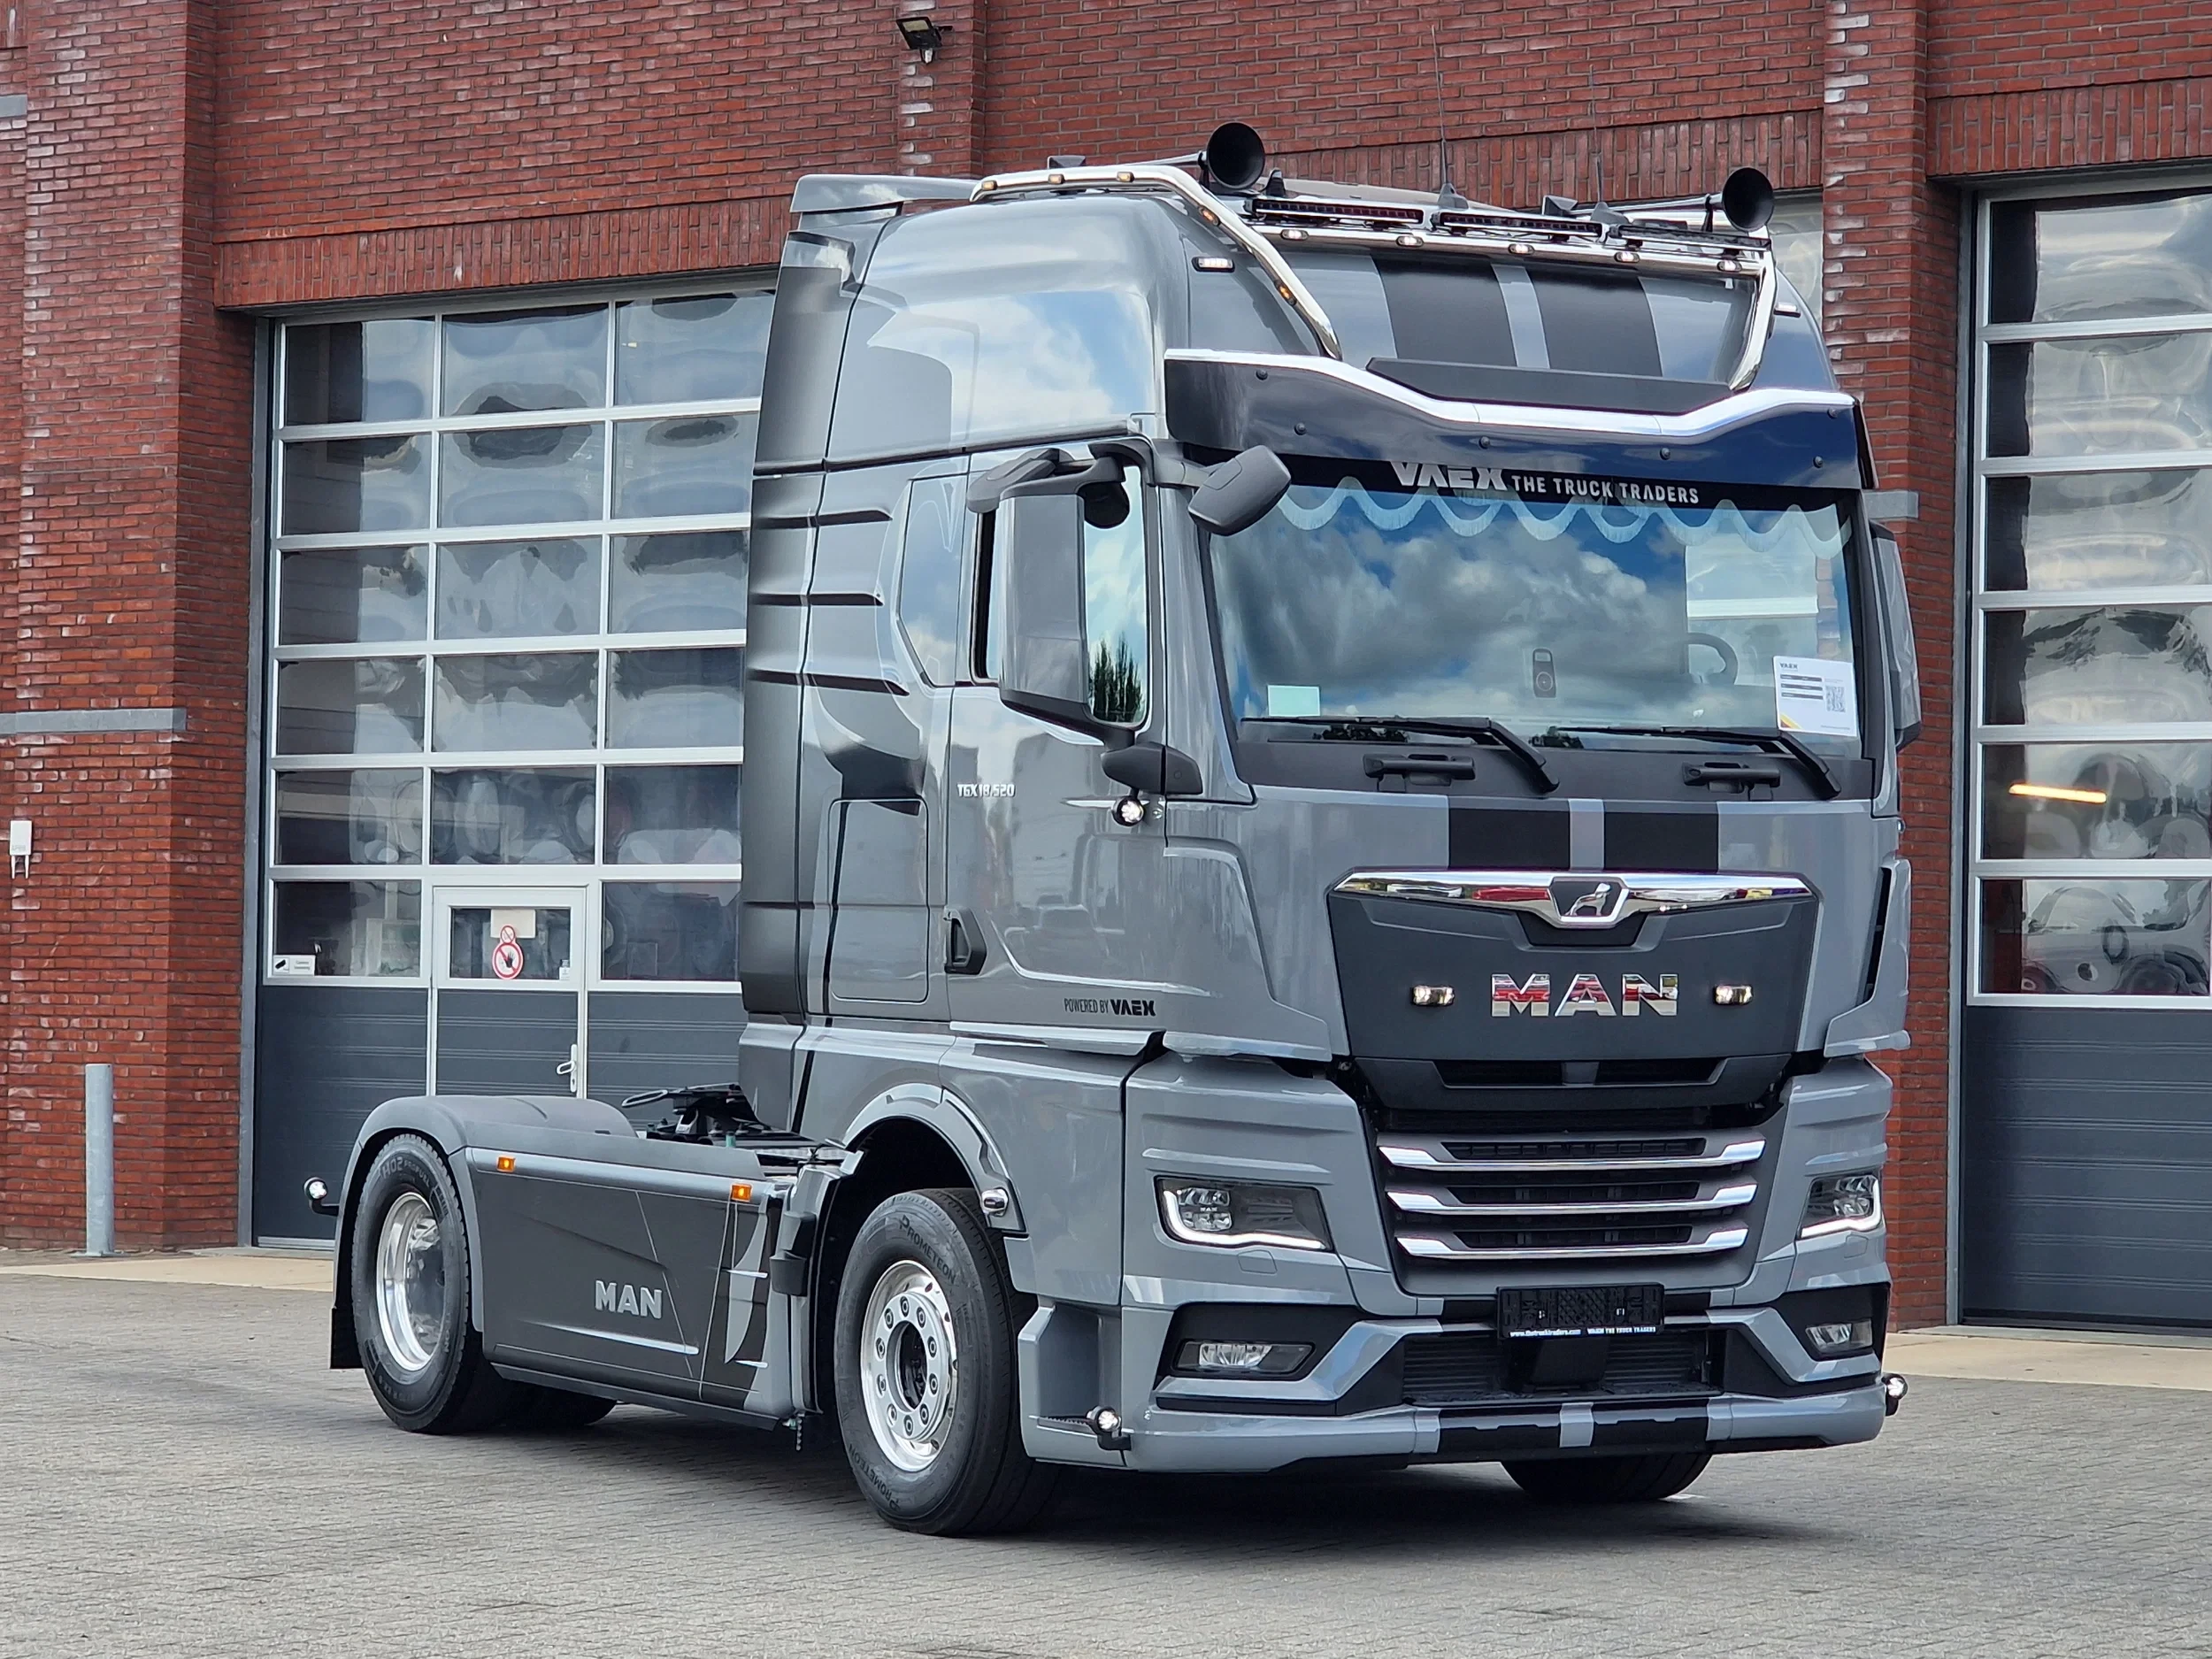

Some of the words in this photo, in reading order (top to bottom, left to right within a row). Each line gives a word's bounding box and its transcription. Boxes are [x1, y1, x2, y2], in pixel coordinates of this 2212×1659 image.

[1390, 460, 1508, 491] VAEX
[1511, 475, 1547, 493] THE
[1553, 478, 1614, 498] TRUCK
[1619, 482, 1699, 503] TRADERS
[1064, 998, 1098, 1013] POWERED
[1099, 1000, 1109, 1013] BY
[1110, 999, 1156, 1017] VAEX
[1492, 973, 1678, 1017] MAN
[899, 1214, 956, 1284] PROMETEON
[595, 1279, 662, 1319] MAN
[849, 1443, 901, 1511] PROMETEON
